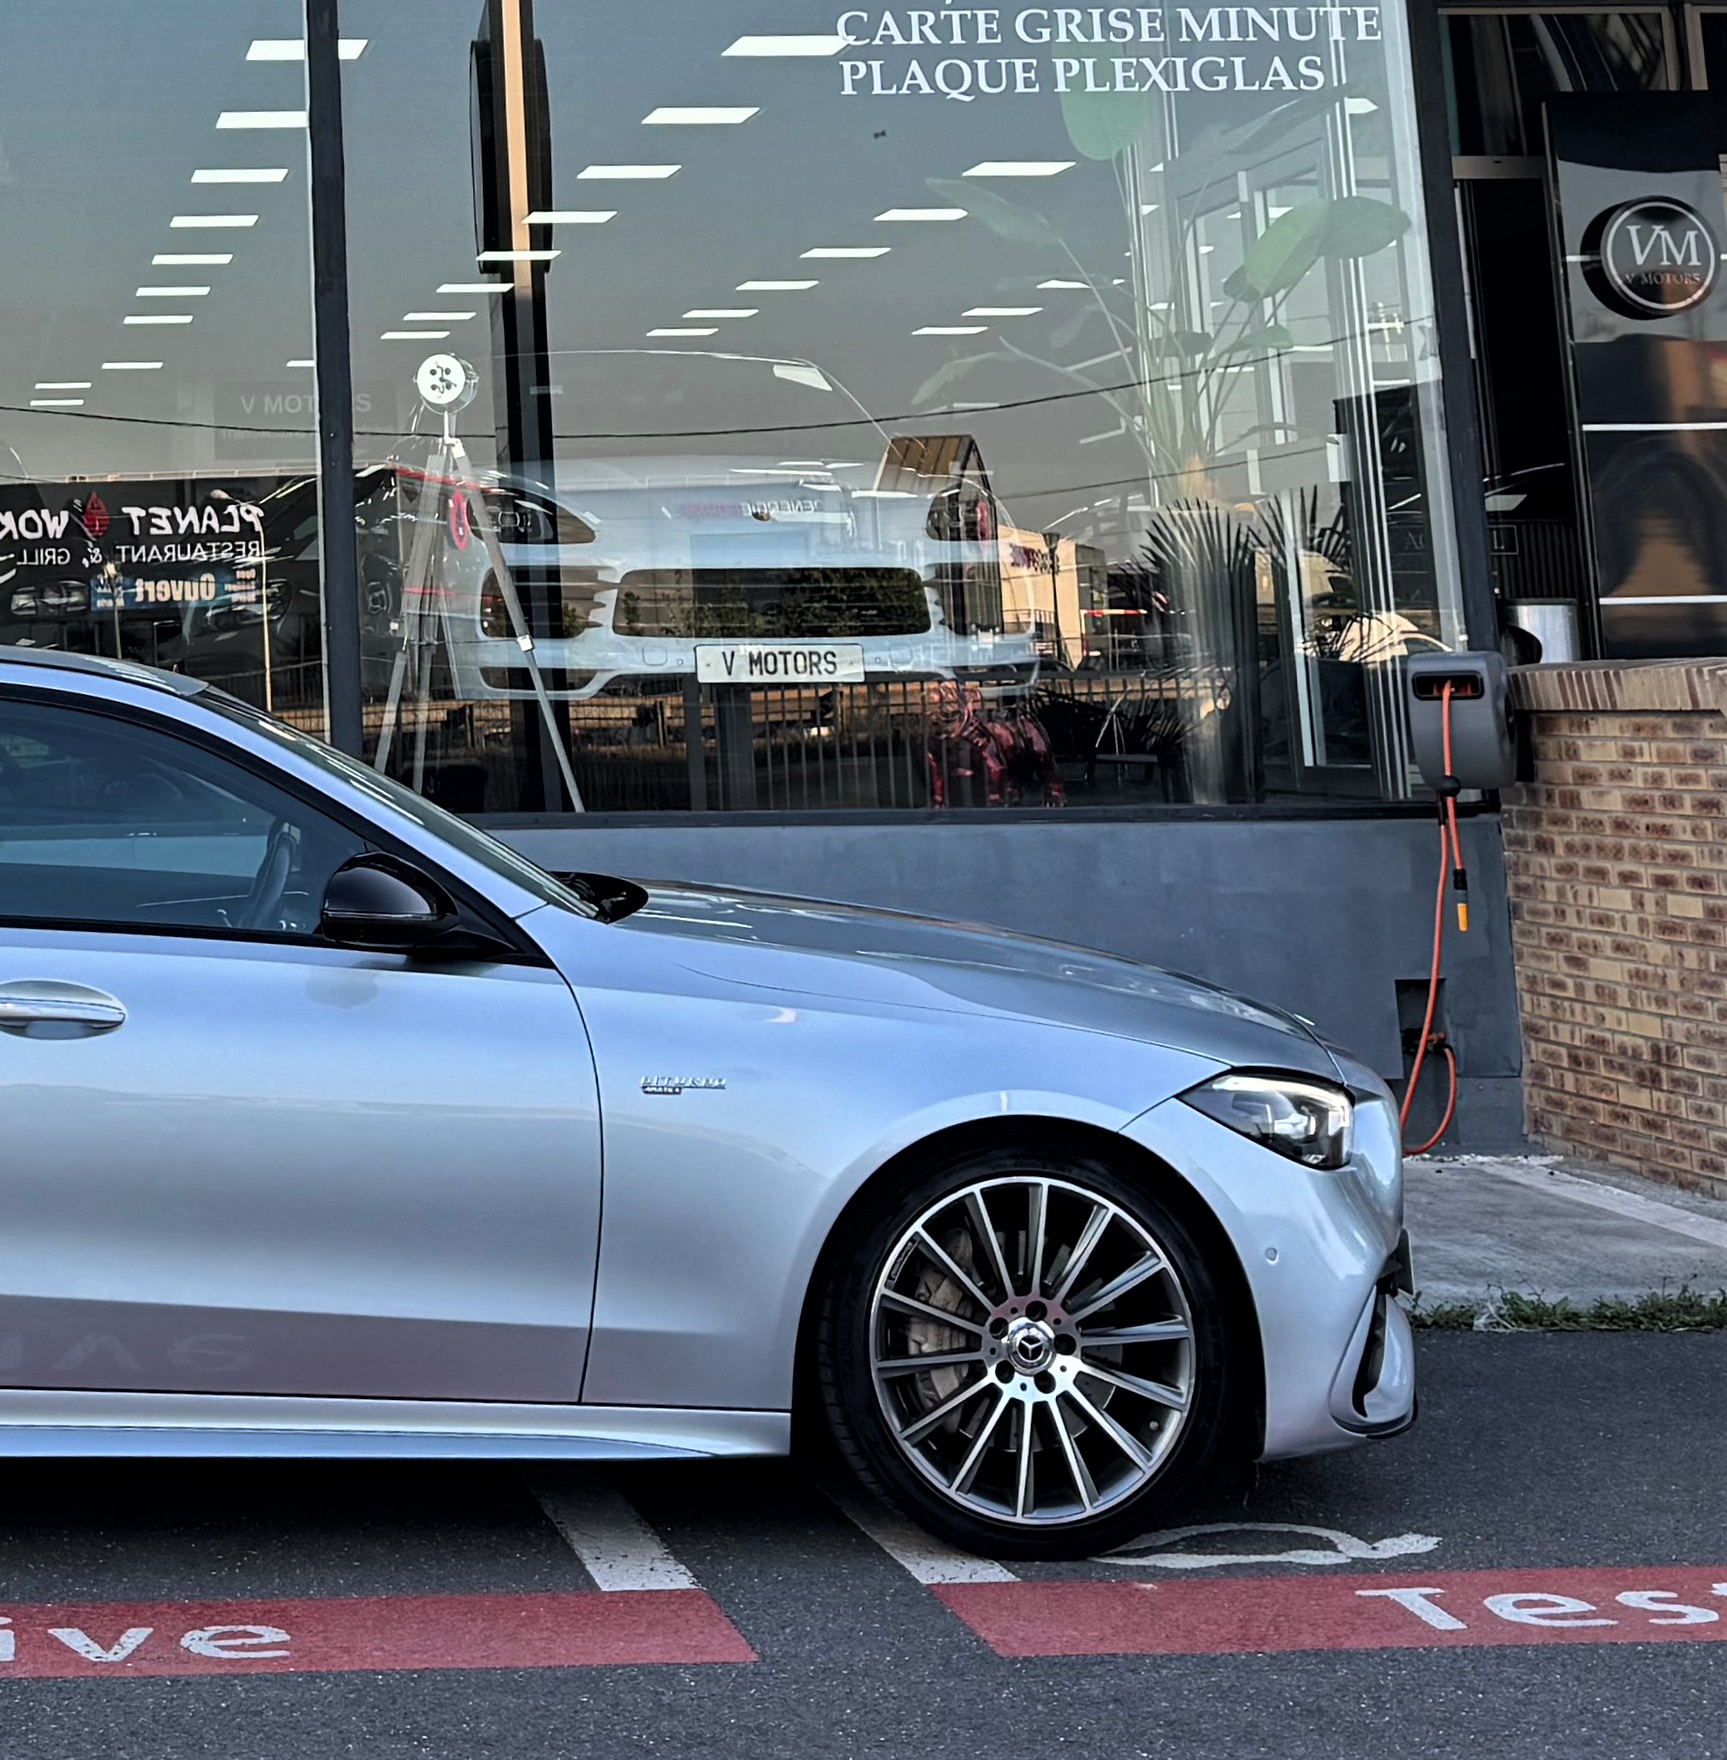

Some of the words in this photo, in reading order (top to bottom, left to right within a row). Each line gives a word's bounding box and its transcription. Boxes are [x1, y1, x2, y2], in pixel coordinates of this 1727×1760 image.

[836, 10, 1002, 46] CARTE
[1014, 8, 1165, 44] GRISE
[1175, 7, 1382, 42] MINUTE
[838, 59, 1040, 102] PLAQUE
[1051, 56, 1325, 93] PLEXIGLAS
[1626, 225, 1702, 266] VM
[1641, 272, 1701, 285] MOTORS
[240, 395, 256, 414] V
[264, 393, 372, 415] MOTS
[722, 651, 735, 676] V
[749, 650, 837, 676] MOTORS
[1354, 1582, 1727, 1631] Tes
